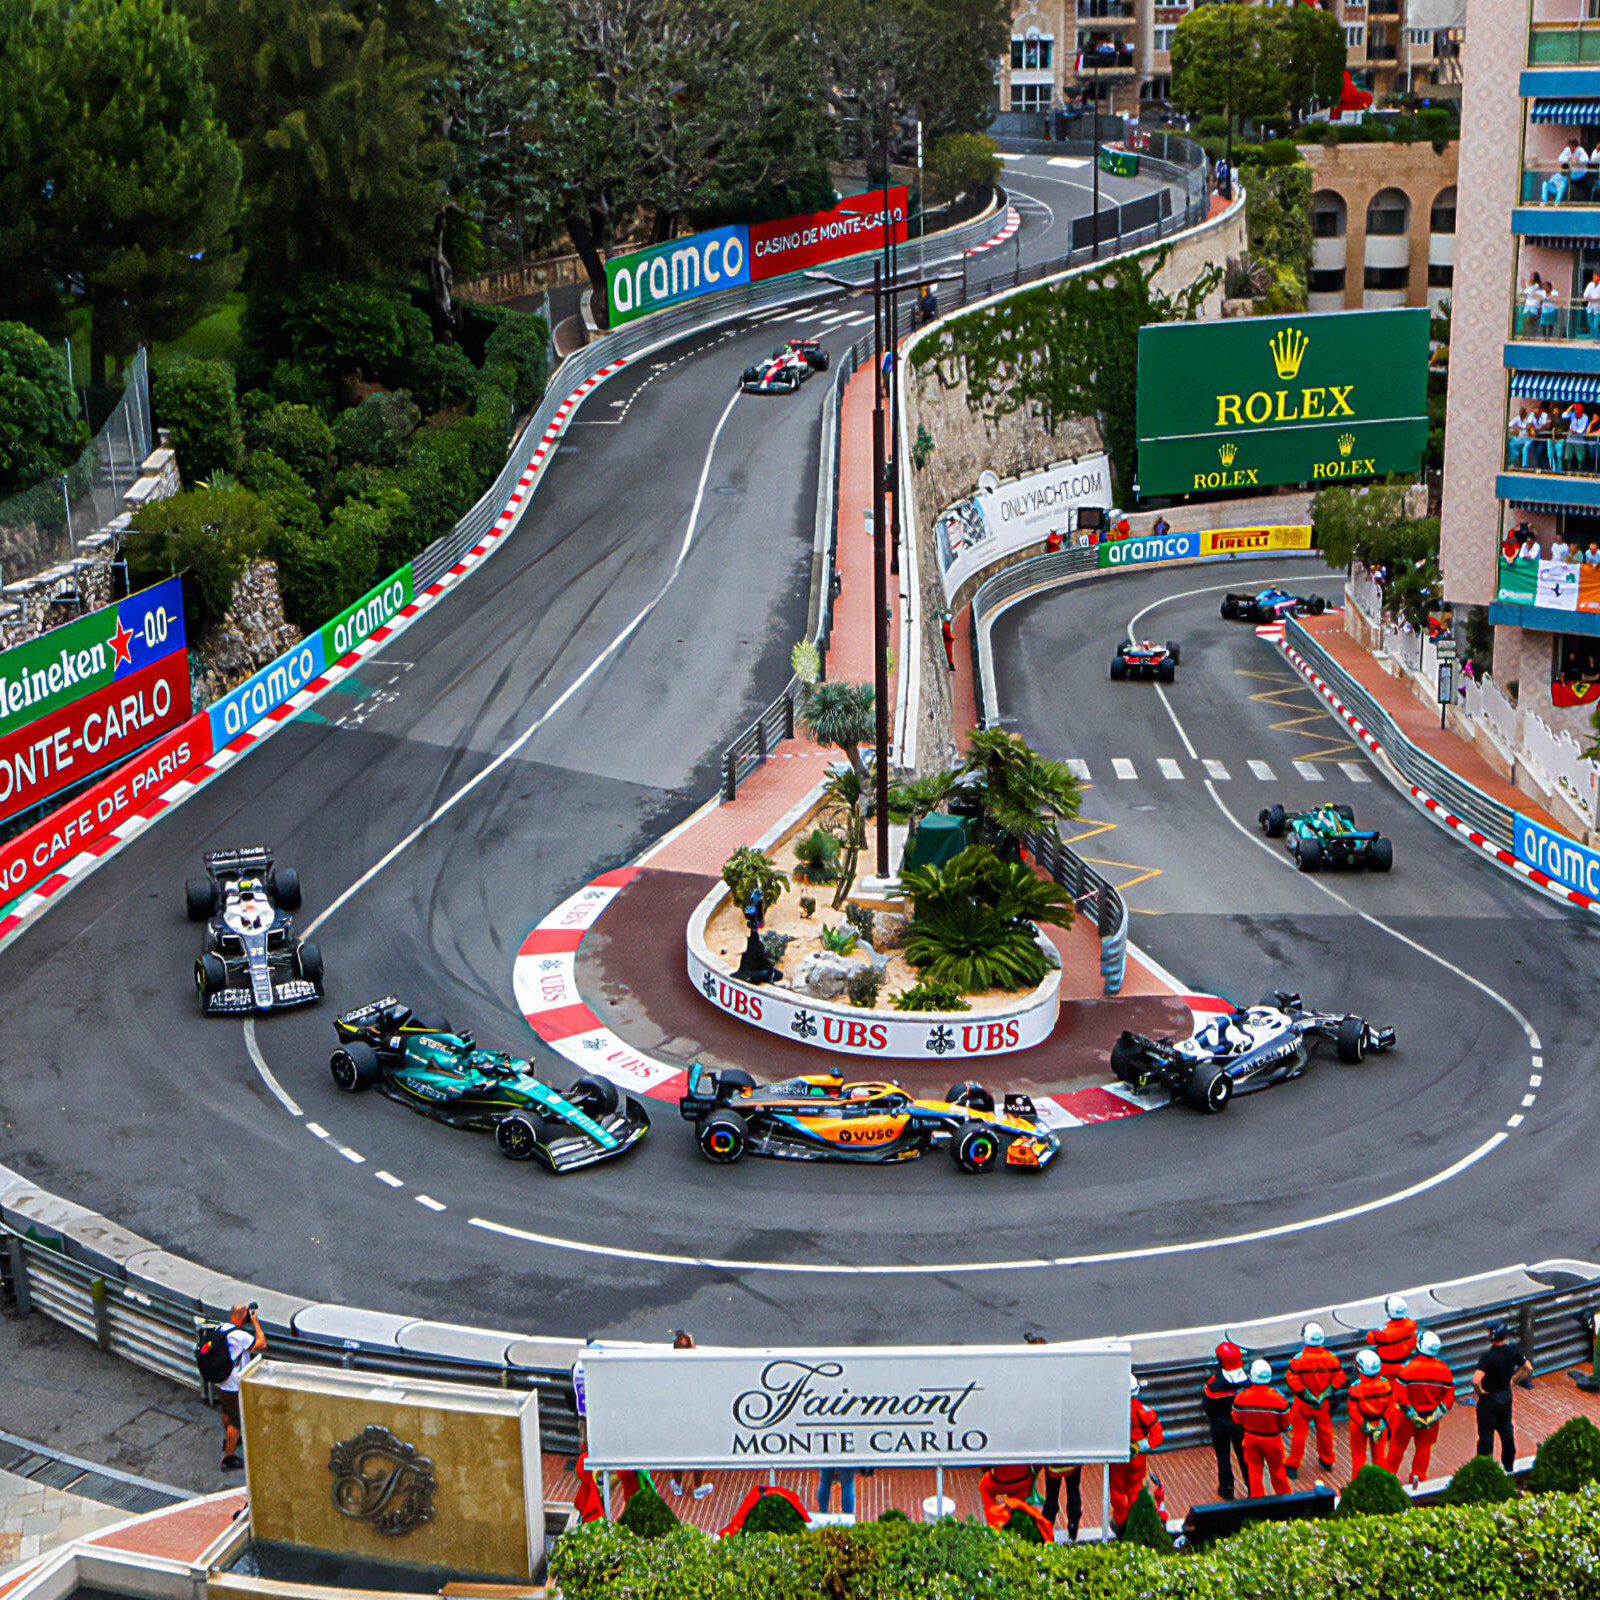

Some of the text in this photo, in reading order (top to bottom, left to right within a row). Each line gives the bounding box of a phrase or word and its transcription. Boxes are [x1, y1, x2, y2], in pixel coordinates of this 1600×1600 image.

[755, 233, 800, 257] CASINO
[802, 227, 818, 246] DE
[613, 236, 743, 312] aramco
[1214, 385, 1355, 427] ROLEX
[1193, 469, 1259, 490] ROLEX
[1312, 458, 1376, 479] ROLEX
[1108, 538, 1189, 562] aramco
[1211, 530, 1270, 550] PIRELLI
[334, 579, 403, 653] aramco
[224, 648, 313, 735] aramco
[32, 809, 95, 867] CAFE
[97, 785, 129, 823] DE
[132, 741, 191, 798] PARIS
[560, 902, 596, 926] UBS
[540, 974, 567, 1002] UBS
[719, 982, 764, 1022] UBS
[823, 1016, 888, 1051] UBS
[961, 1019, 1021, 1053] UBS
[606, 1050, 658, 1079] UBS
[733, 1359, 985, 1430] Fairmont
[733, 1429, 988, 1456] MONTE CARLO
